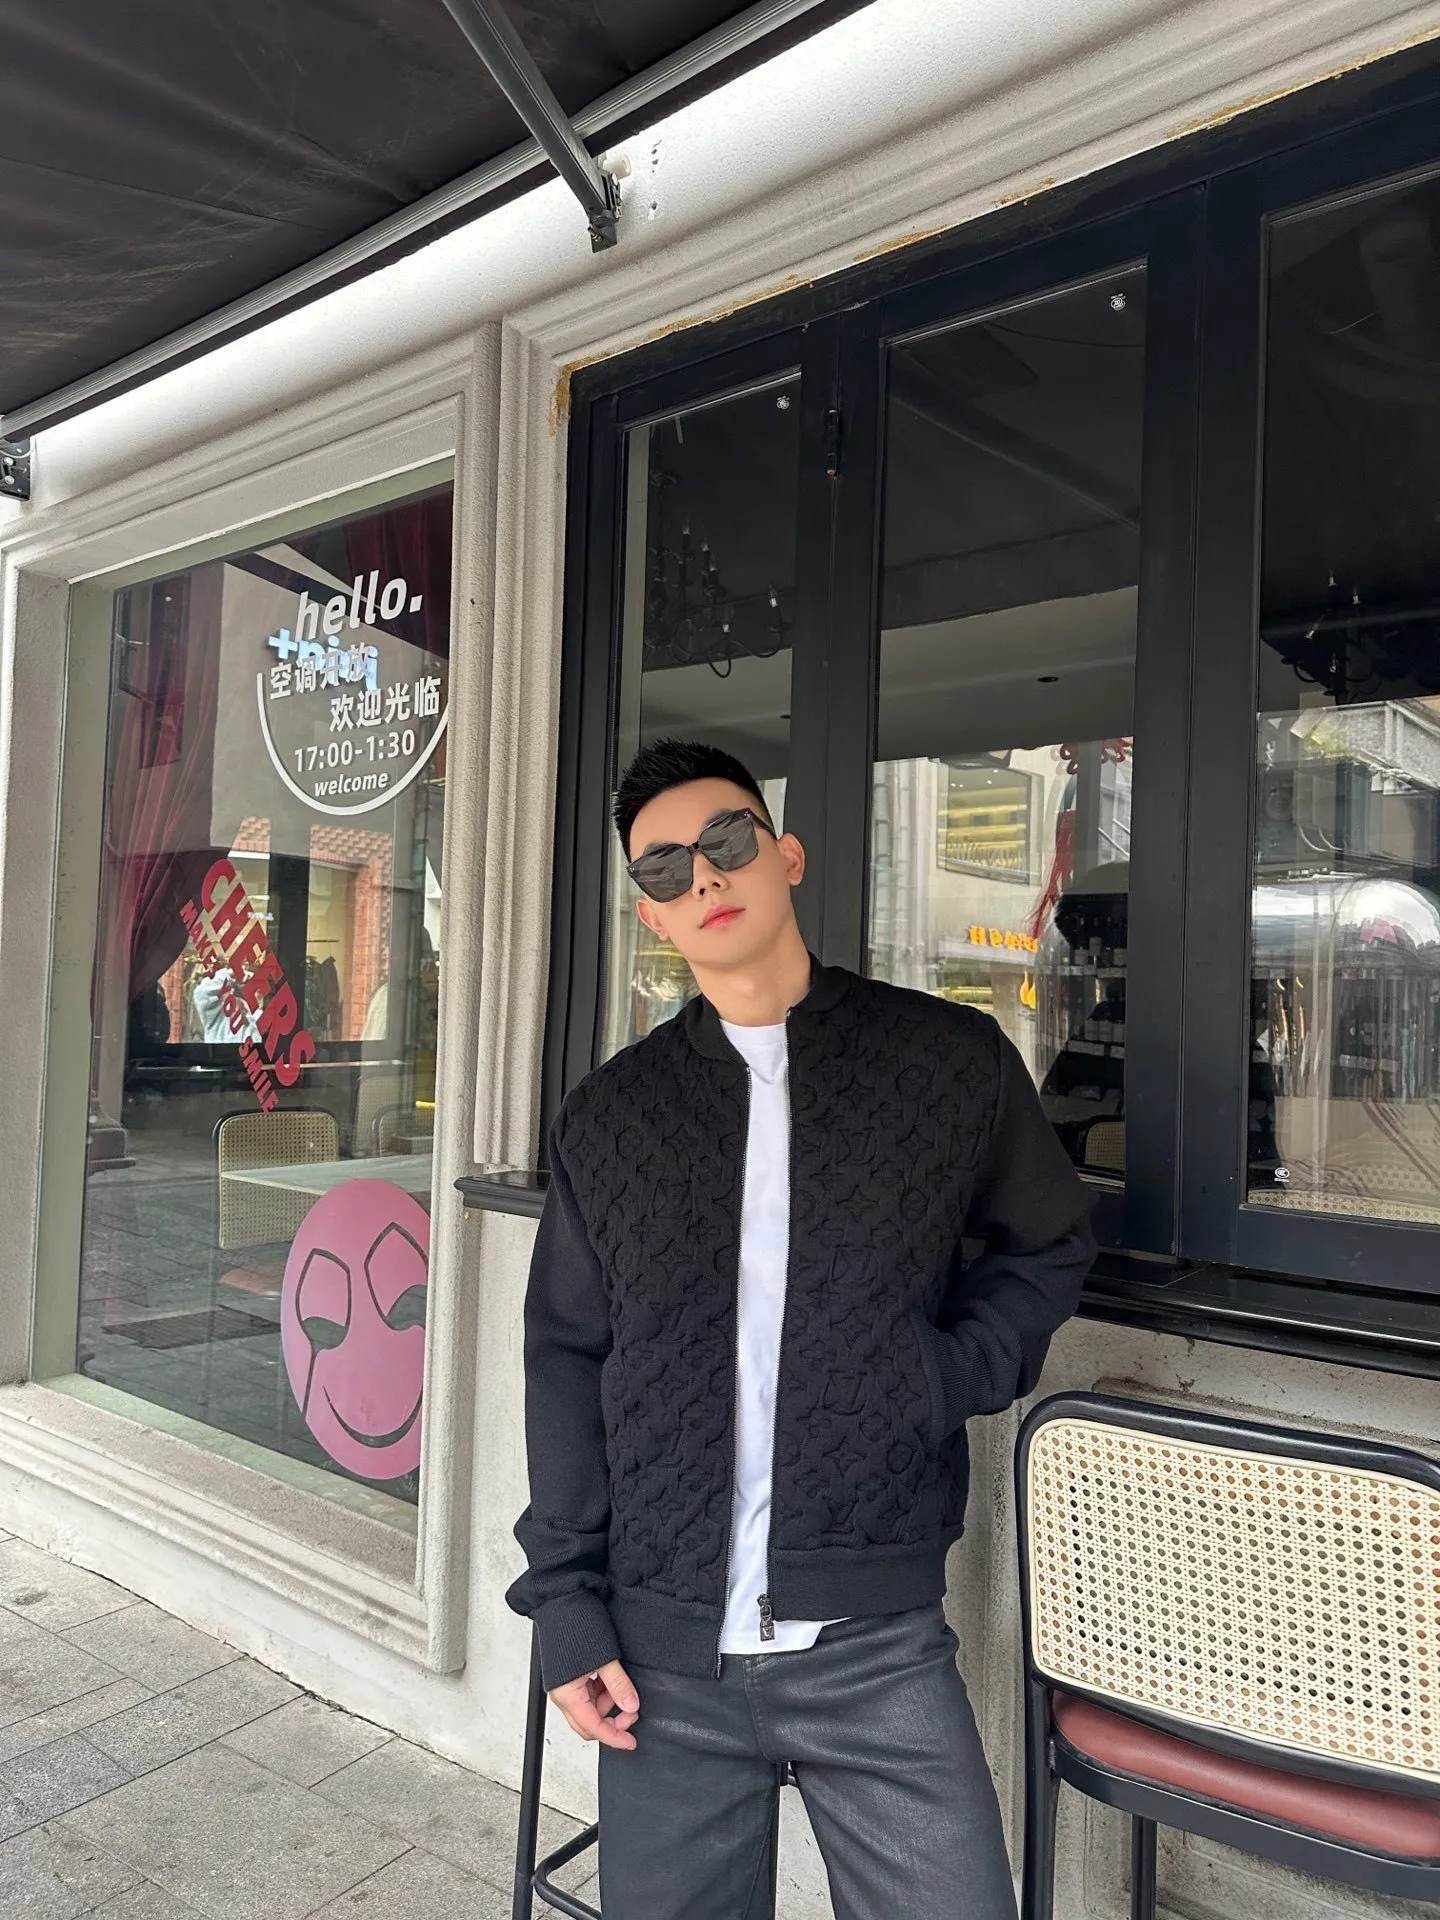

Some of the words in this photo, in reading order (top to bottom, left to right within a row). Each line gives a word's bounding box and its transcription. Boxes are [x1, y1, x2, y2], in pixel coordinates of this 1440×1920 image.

[294, 569, 423, 643] hello.
[269, 641, 371, 700] 空调开放
[329, 675, 442, 732] 欢迎光临
[294, 729, 416, 773] 17:00-1:30
[314, 772, 389, 797] welcome
[201, 858, 316, 1087] CHEERS
[216, 977, 245, 1035] YOU
[238, 1035, 279, 1115] SMILE
